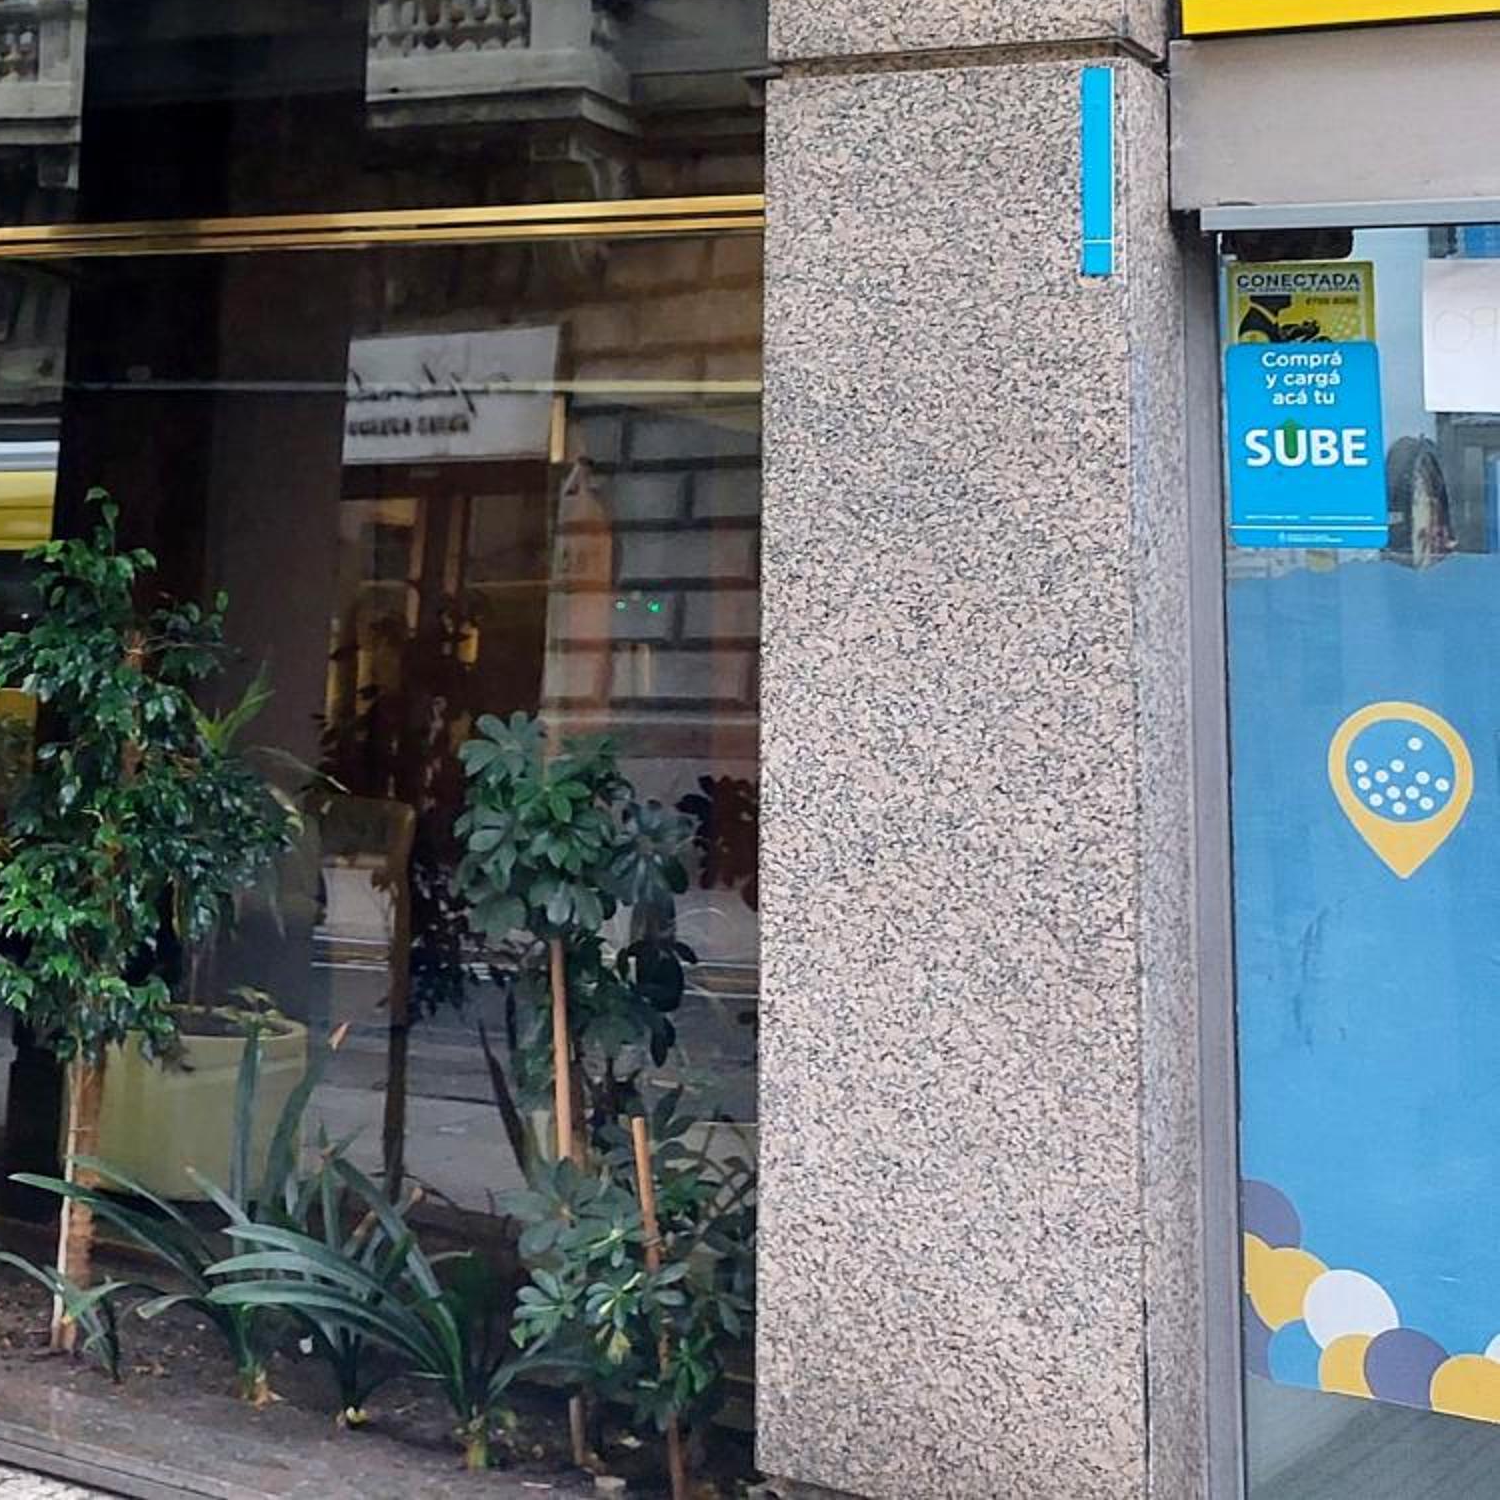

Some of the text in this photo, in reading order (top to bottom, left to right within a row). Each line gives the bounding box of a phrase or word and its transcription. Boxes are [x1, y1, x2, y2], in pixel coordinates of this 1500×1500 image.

[1237, 273, 1361, 288] CONECTADA
[1261, 350, 1342, 369] Comprá
[1265, 369, 1341, 389] y cargá
[1272, 388, 1336, 405] acá tu
[1245, 428, 1368, 467] SUBE
